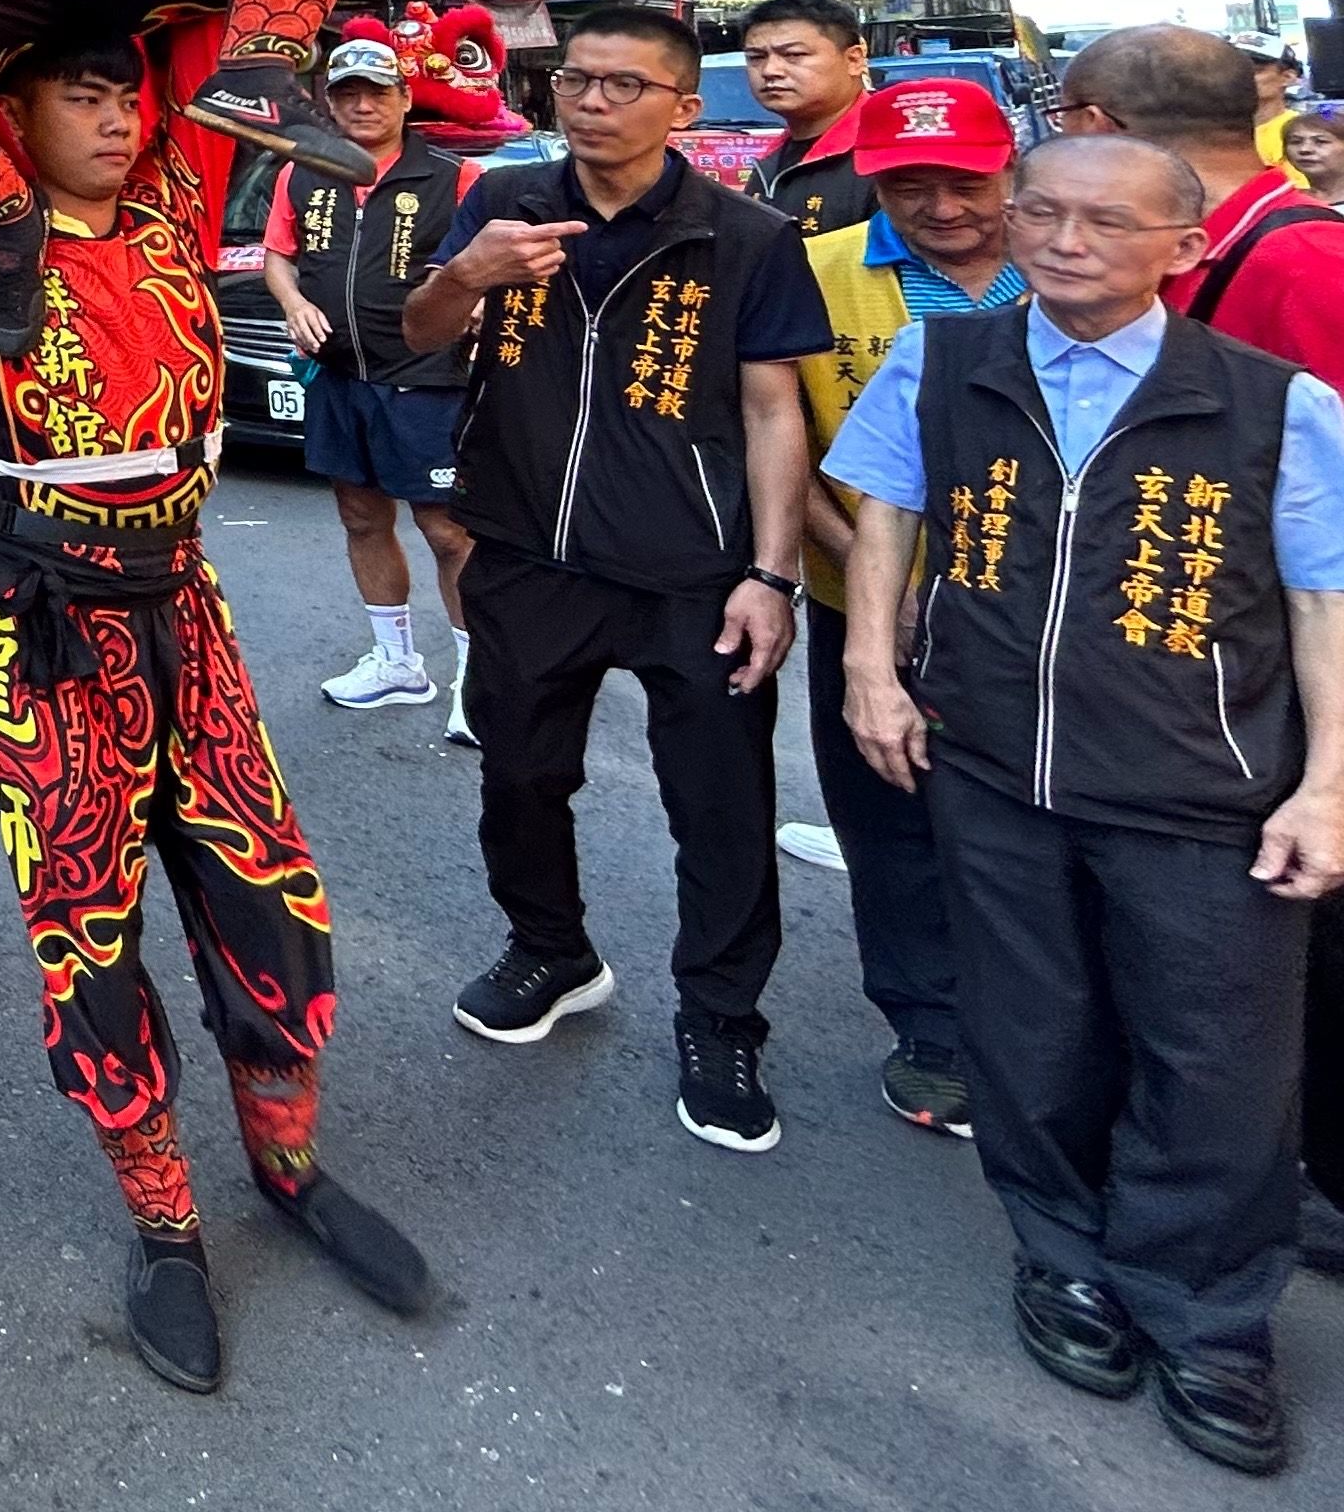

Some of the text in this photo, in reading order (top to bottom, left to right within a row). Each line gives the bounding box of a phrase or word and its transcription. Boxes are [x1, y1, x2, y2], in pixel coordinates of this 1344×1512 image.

[624, 274, 678, 410] 玄天上帝會
[654, 278, 711, 421] 新北市道教
[976, 457, 1020, 593] 創會理事長
[1112, 466, 1176, 648] 玄天上帝會
[1164, 473, 1232, 660] 新北市道教
